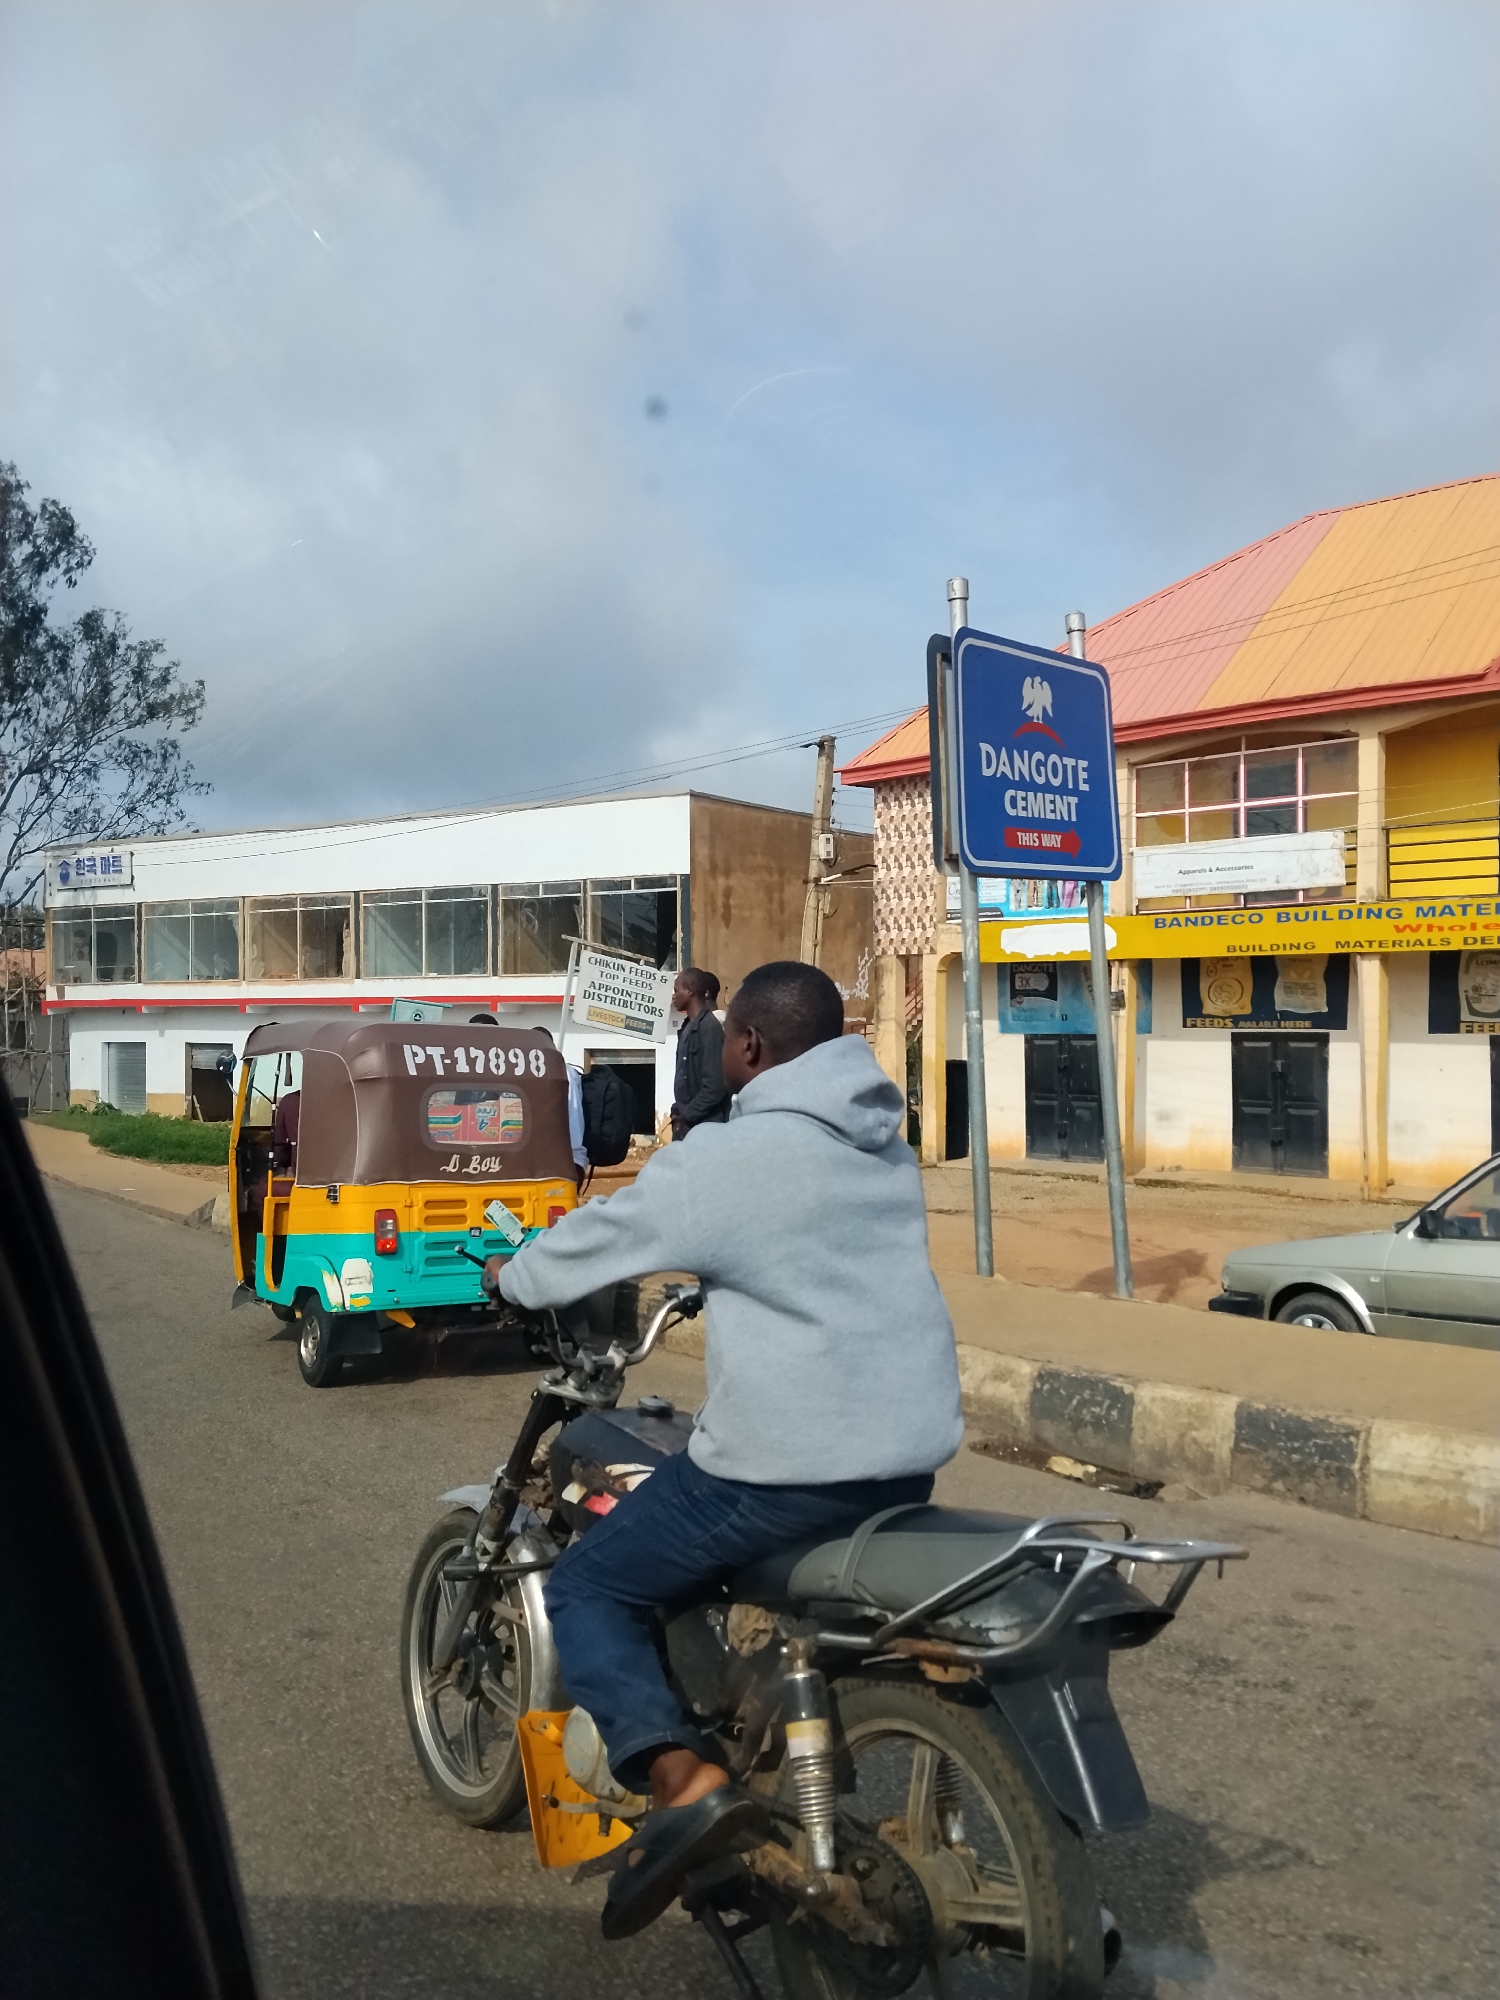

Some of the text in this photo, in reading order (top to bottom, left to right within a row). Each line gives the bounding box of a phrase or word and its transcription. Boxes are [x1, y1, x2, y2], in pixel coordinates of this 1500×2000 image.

[979, 742, 1089, 791] DANGOTE
[1004, 789, 1078, 822] CEMENT
[1016, 832, 1062, 848] THIS WAY
[75, 855, 123, 876] 한국 마트
[1215, 863, 1254, 872] Accessories
[1154, 902, 1500, 929] BANDECO BUILDING MATE
[1393, 922, 1500, 933] Whole
[1226, 936, 1500, 953] BUILDING MATERIALS DE
[588, 956, 668, 984] CHIKUN FEEDS &
[1012, 963, 1055, 973] DANGOTE
[599, 970, 653, 991] TOP FEEDS
[1018, 976, 1031, 988] 3X
[588, 980, 655, 1004] APPOINTED
[582, 989, 665, 1018] DISTRIBUTORS
[588, 1009, 625, 1024] LIVESTOCK
[626, 1018, 646, 1030] FEEDS
[1280, 1020, 1312, 1028] HERE
[1460, 1022, 1500, 1034] FEE
[402, 1044, 546, 1078] PT-17898
[476, 1107, 497, 1117] Free
[478, 1118, 490, 1131] 4
